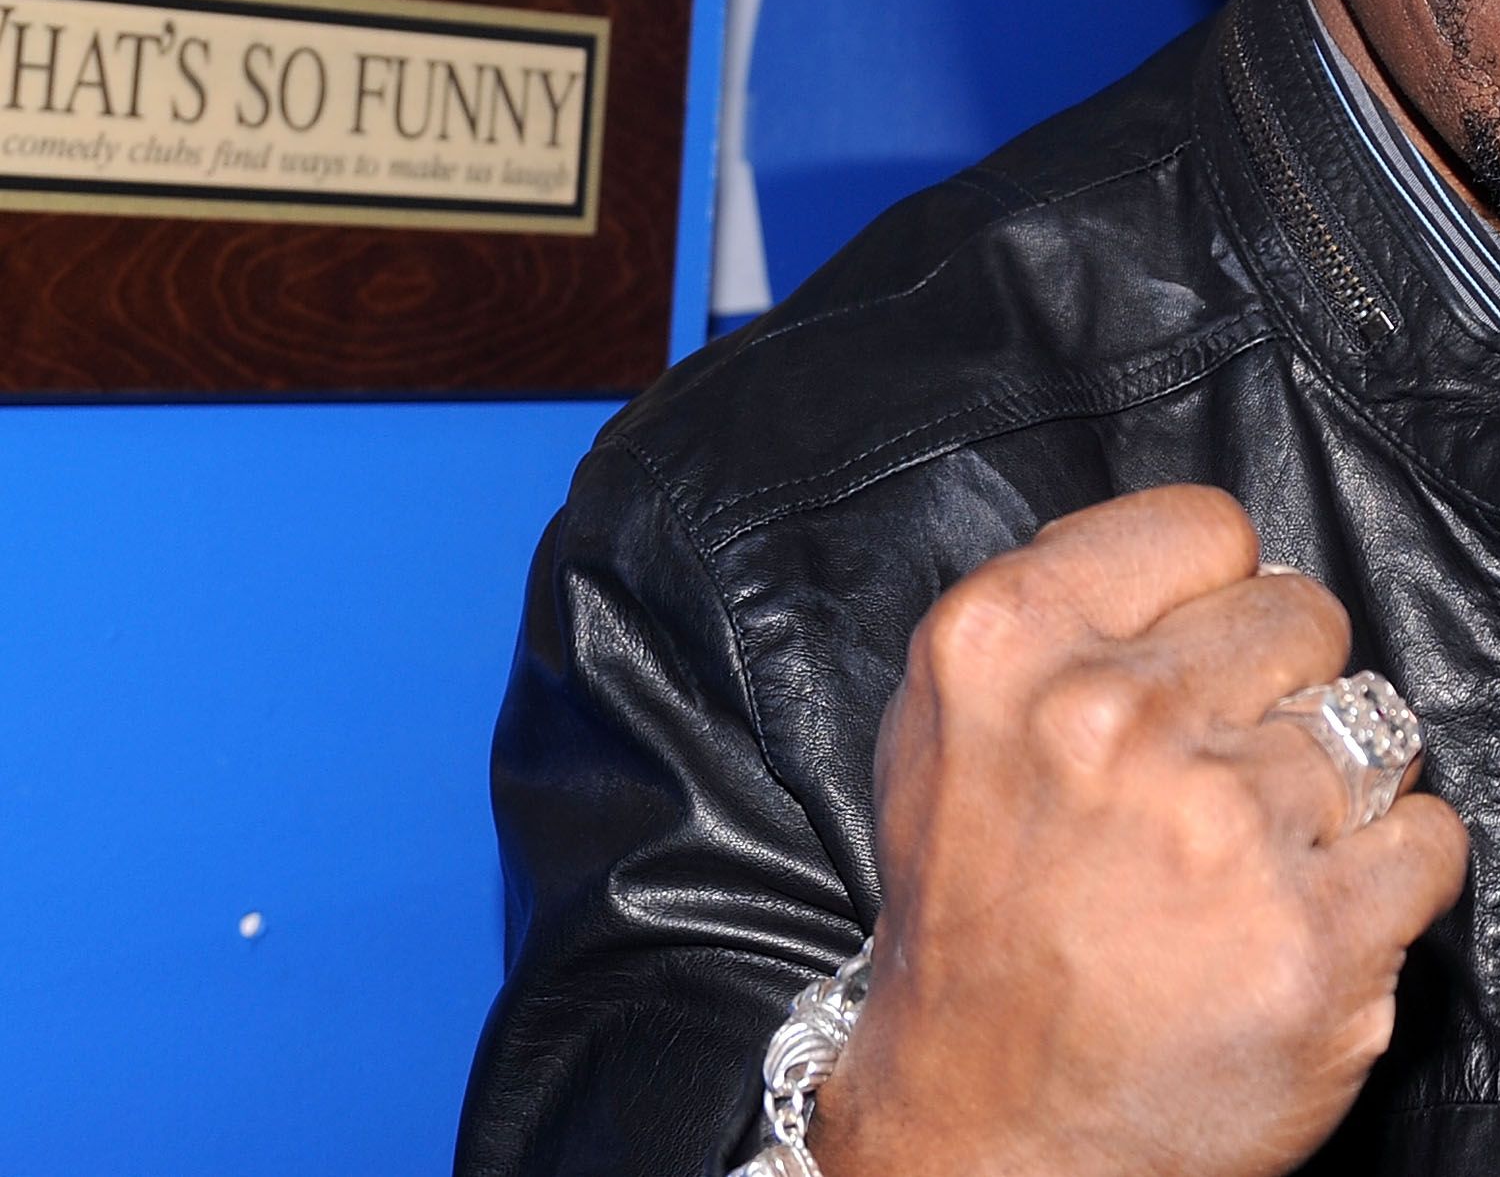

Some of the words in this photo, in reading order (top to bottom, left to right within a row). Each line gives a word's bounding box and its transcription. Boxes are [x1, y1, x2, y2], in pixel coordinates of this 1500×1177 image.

[235, 41, 328, 133] SO
[349, 53, 581, 150] FUNNY
[2, 133, 120, 169] comedy
[128, 135, 203, 165] clubs
[208, 138, 273, 176] find
[280, 153, 346, 183] ways
[354, 153, 380, 175] to
[389, 154, 457, 180] make
[464, 164, 493, 183] us
